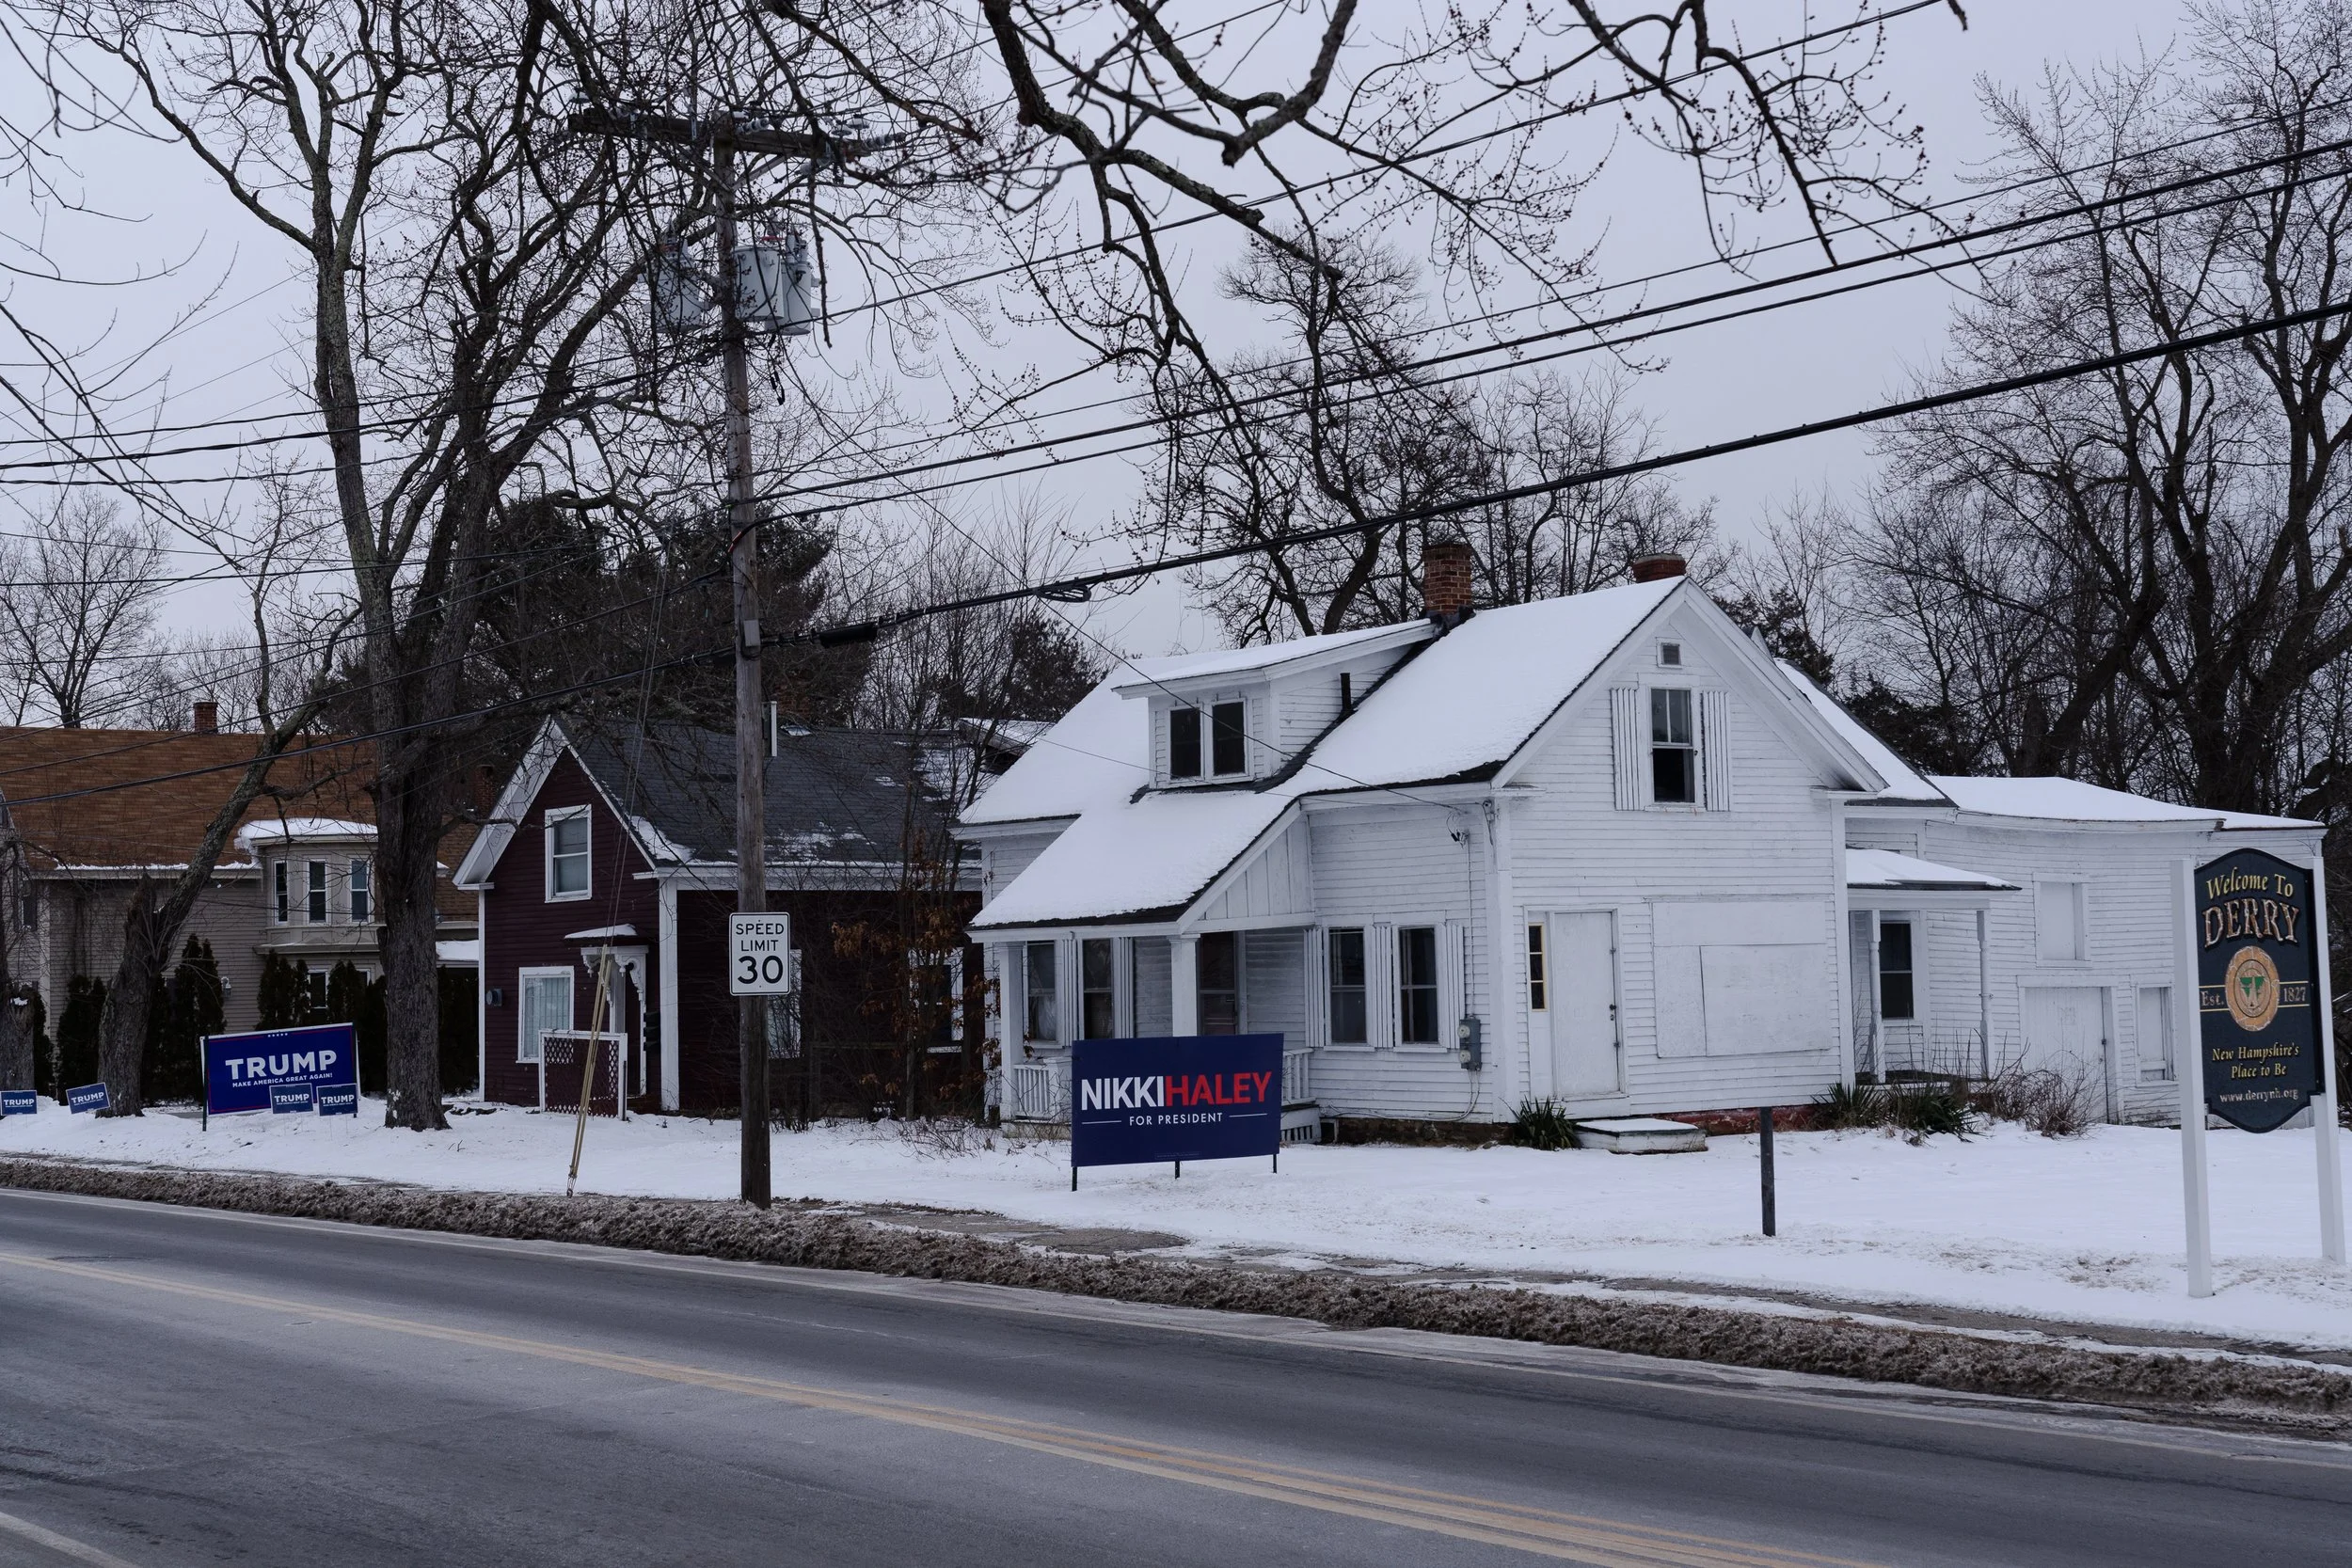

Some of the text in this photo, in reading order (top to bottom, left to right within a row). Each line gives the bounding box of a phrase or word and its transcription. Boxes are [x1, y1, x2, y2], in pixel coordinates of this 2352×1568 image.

[2206, 866, 2294, 899] Welcome To
[736, 924, 784, 935] SPEED
[2202, 898, 2299, 947] DERRY
[741, 940, 779, 951] LIMIT
[738, 956, 784, 984] 30
[2201, 987, 2306, 1006] Est. 1827
[2212, 1041, 2300, 1064] New Hampshire's
[225, 1050, 337, 1080] TRUMP
[2232, 1063, 2287, 1079] Place to Be
[71, 1092, 104, 1103] TRUMP
[274, 1093, 310, 1102] TRUMP
[321, 1094, 355, 1103] TRUMP
[2219, 1087, 2298, 1102] www.derrynh.org
[1129, 1112, 1223, 1126] FOR PRESIDENT
